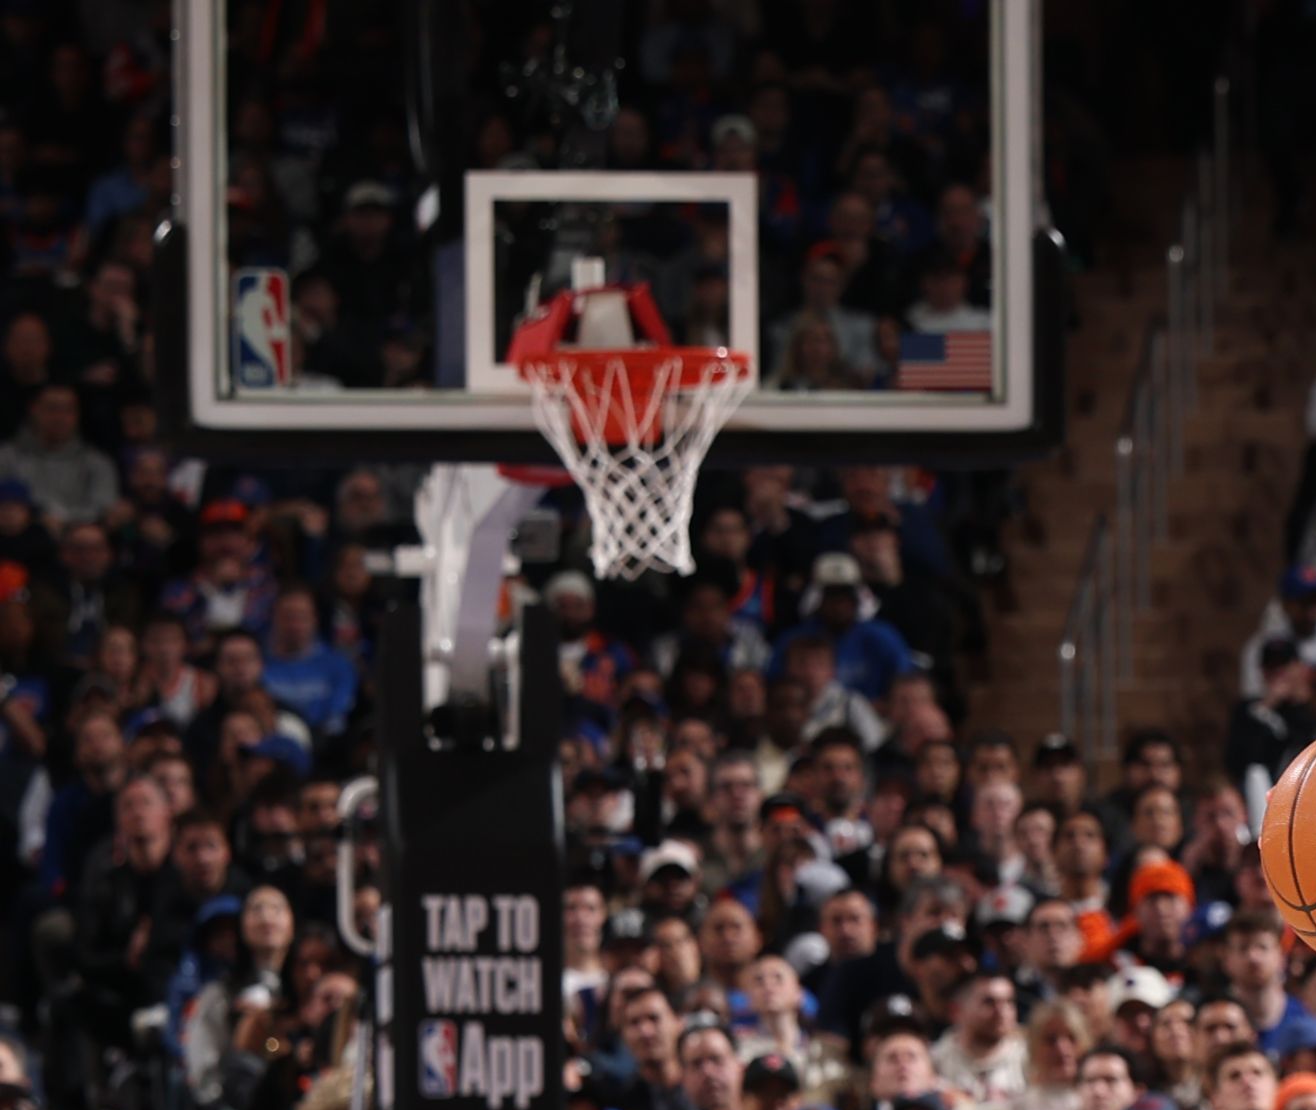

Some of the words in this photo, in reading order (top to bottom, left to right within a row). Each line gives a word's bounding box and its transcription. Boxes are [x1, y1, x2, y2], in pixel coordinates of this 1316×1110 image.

[421, 894, 489, 952] TAP
[493, 894, 540, 953] TO
[421, 955, 542, 1015] WATCH
[461, 1020, 545, 1110] App
